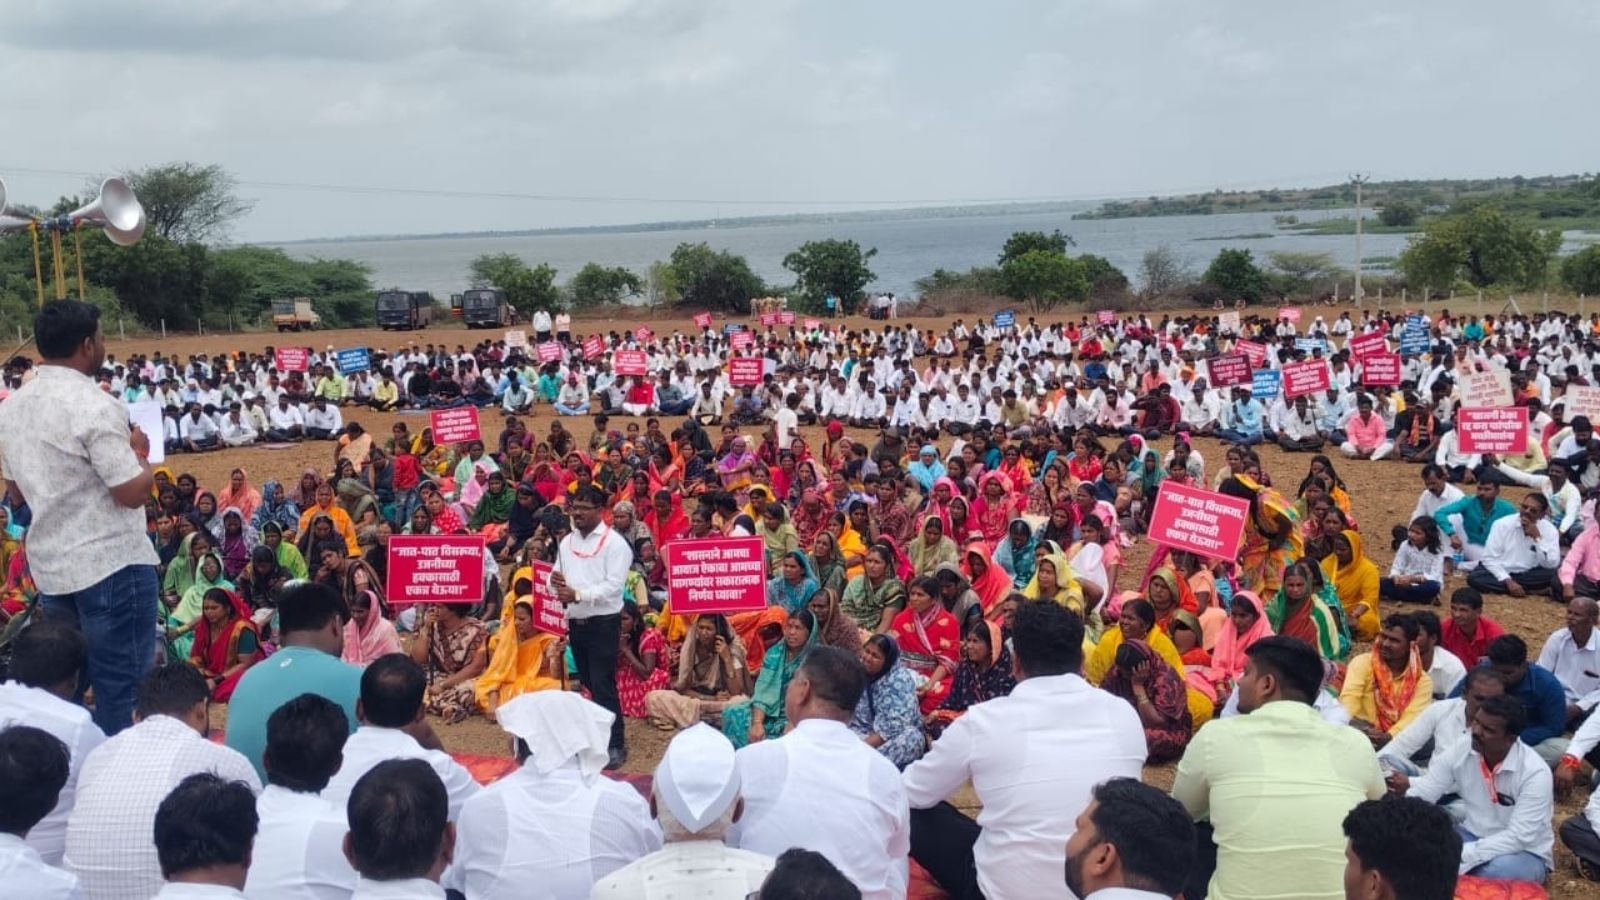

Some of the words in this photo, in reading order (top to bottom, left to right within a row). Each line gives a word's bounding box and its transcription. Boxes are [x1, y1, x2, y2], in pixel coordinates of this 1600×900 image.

[416, 557, 456, 569] उजनीच्या
[412, 569, 460, 583] हक्कासाठी
[405, 585, 430, 595] एकत्र
